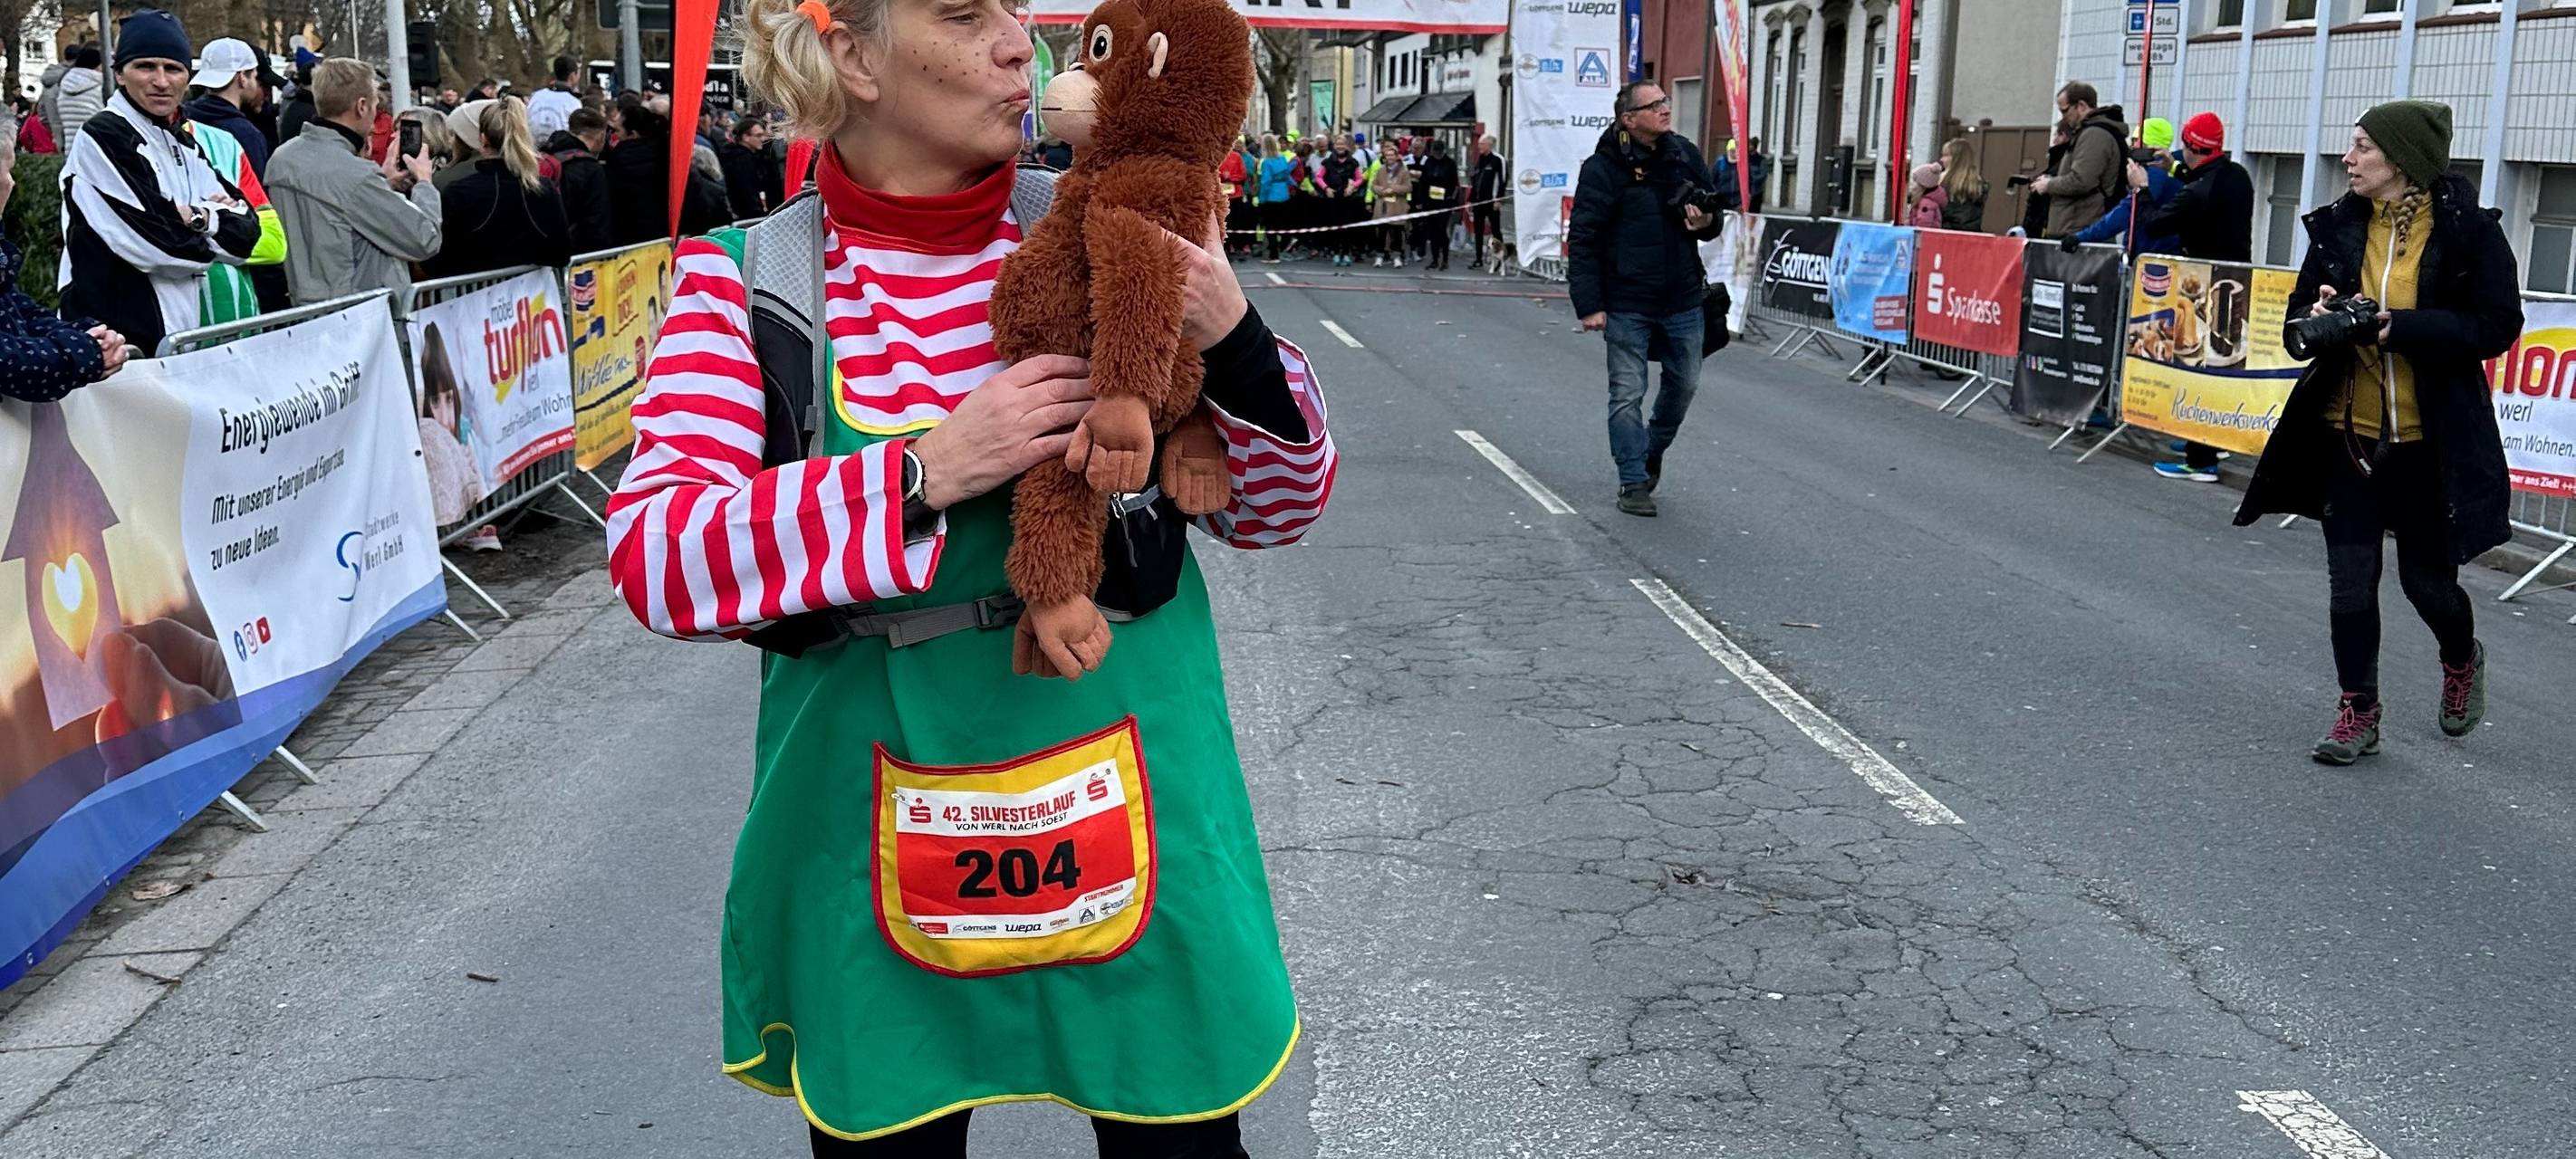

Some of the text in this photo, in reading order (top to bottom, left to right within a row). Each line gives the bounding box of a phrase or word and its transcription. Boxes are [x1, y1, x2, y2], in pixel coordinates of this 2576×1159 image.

[1567, 2, 1617, 17] wepa
[2156, 16, 2173, 26] Std.
[490, 294, 514, 323] möbel
[484, 296, 566, 393] turflon
[219, 360, 361, 455] Energiewende im Griff
[2499, 401, 2533, 423] werl
[2503, 434, 2575, 458] am Wohnen.
[211, 493, 235, 525] Mit
[238, 484, 276, 517] unserer
[277, 465, 304, 501] Energie
[211, 524, 280, 570] zu neue Ideen.
[365, 534, 404, 571] Werl GmbH
[942, 806, 966, 822] 42.
[971, 790, 1076, 823] SILVESTERLAUF
[956, 811, 1068, 832] VON WERL NACH SOEST
[955, 838, 1081, 898] 204
[1004, 923, 1042, 934] wepa
